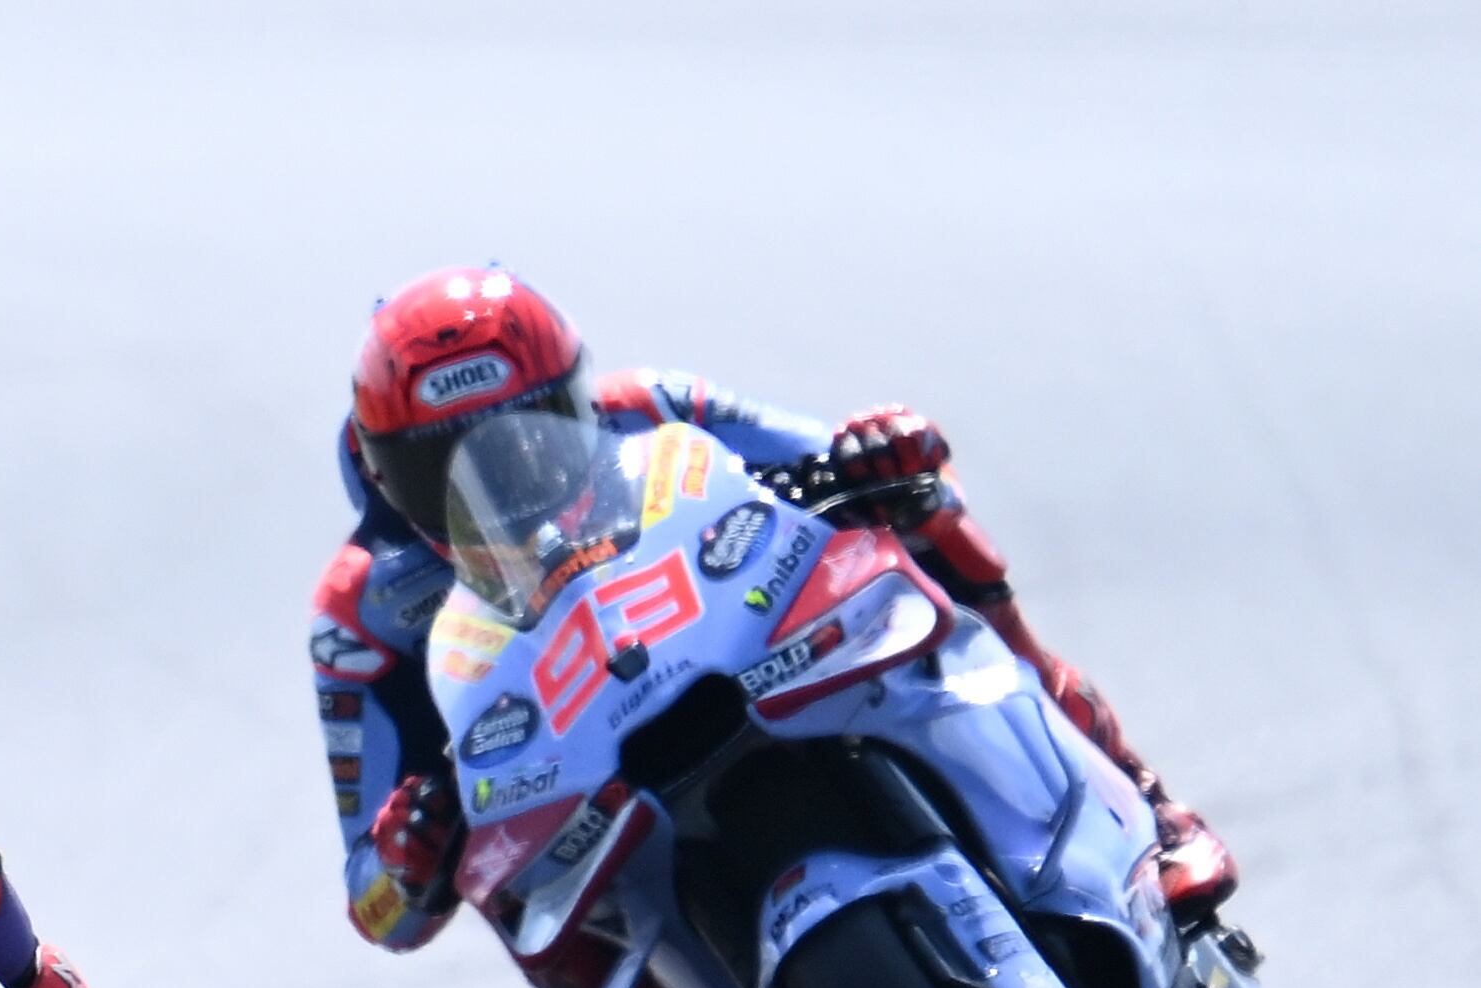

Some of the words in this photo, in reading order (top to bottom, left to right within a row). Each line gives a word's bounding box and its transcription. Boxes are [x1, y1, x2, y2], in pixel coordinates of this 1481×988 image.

[428, 360, 500, 397] SHOEI
[531, 547, 703, 737] 93
[738, 642, 811, 691] BOLD
